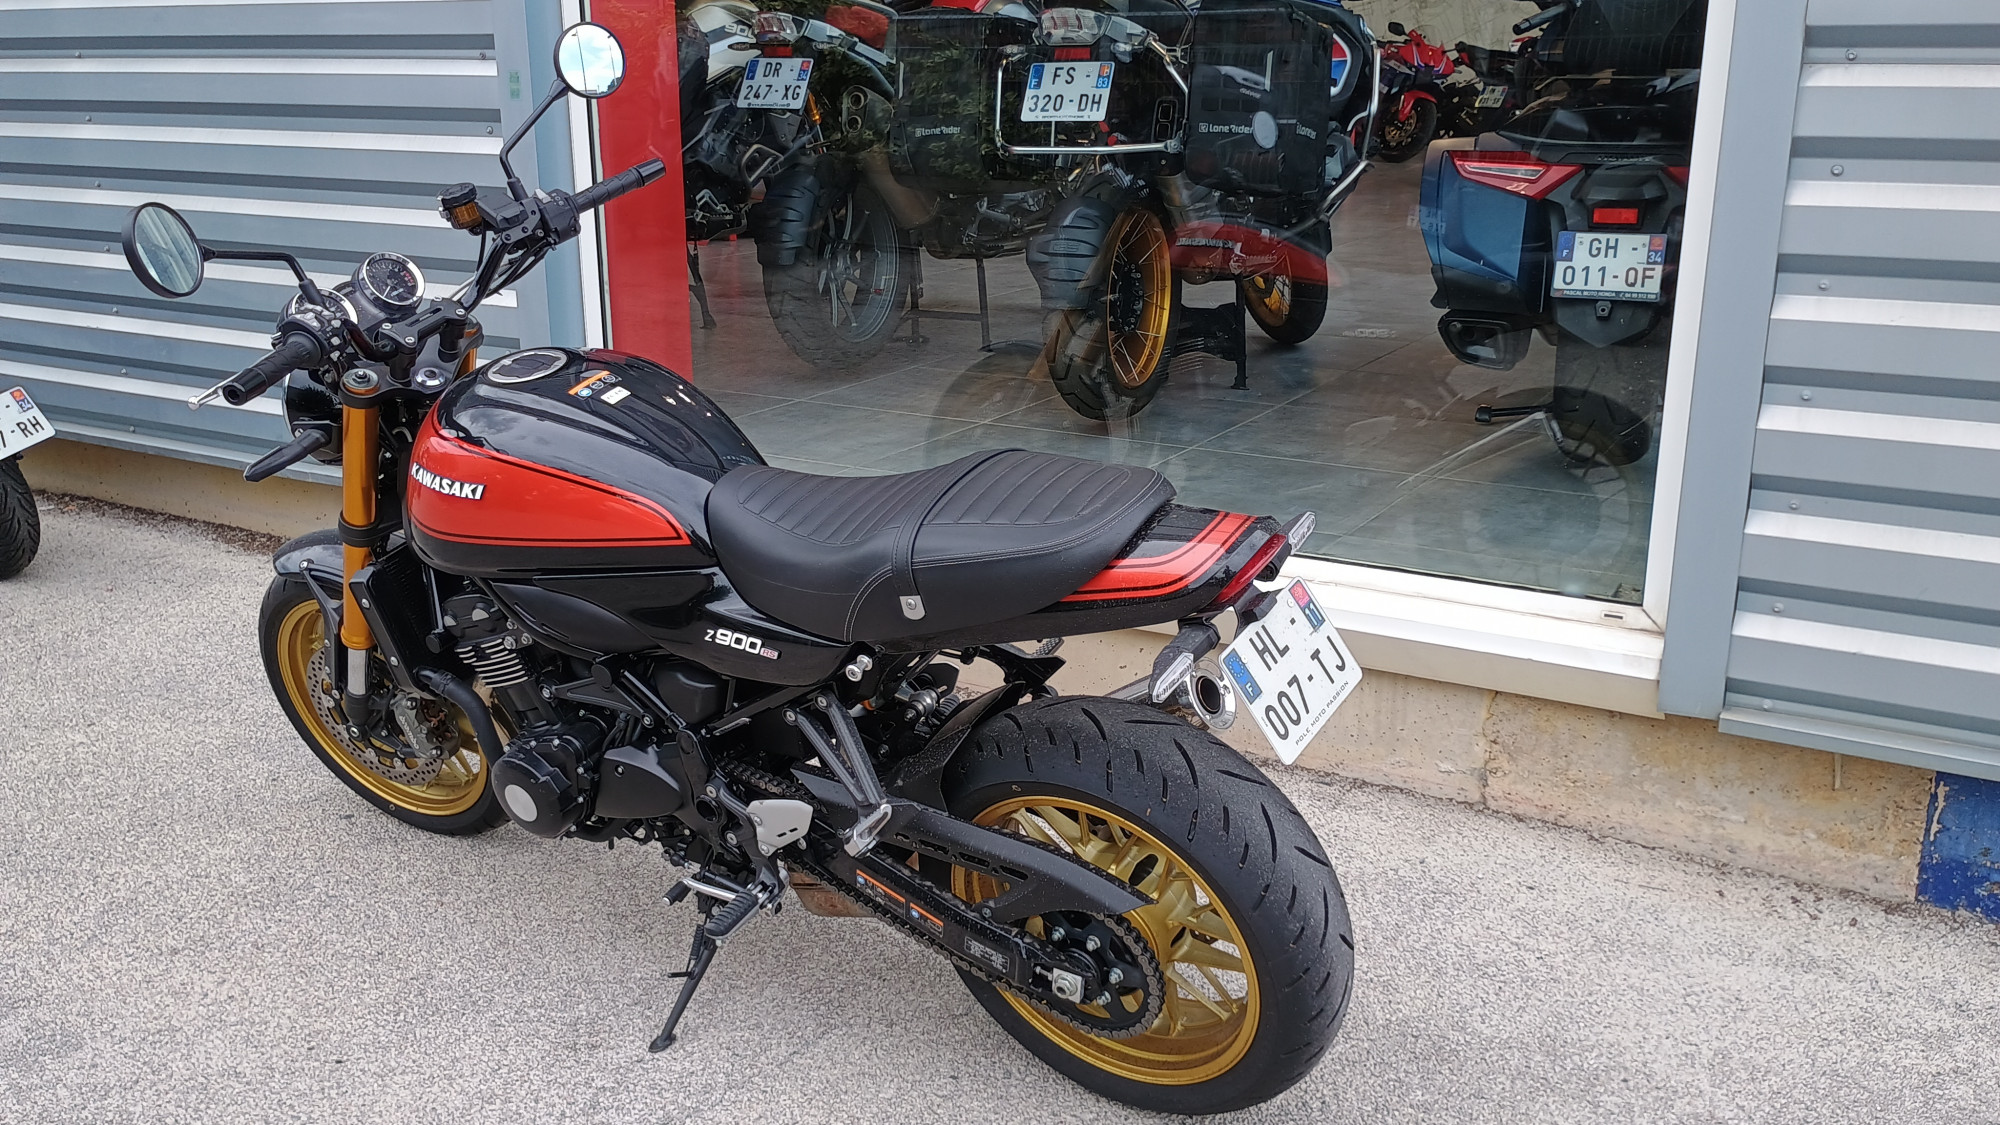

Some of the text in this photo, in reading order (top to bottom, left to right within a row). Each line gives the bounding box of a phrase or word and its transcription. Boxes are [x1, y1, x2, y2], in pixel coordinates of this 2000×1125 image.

[763, 62, 782, 78] DR
[798, 71, 807, 80] 34
[1052, 67, 1076, 85] FS
[1031, 79, 1039, 88] F
[1097, 78, 1108, 87] 83
[1562, 250, 1570, 258] F
[1588, 238, 1619, 259] GH
[1648, 251, 1662, 263] 34
[19, 399, 32, 411] 34
[411, 462, 485, 500] KAWASAKI
[1304, 602, 1324, 626] 11
[1249, 624, 1290, 672] HL
[1245, 682, 1254, 697] F
[1264, 635, 1346, 741] 007-TJ
[1295, 681, 1349, 746] POLE MOTO PASSION
